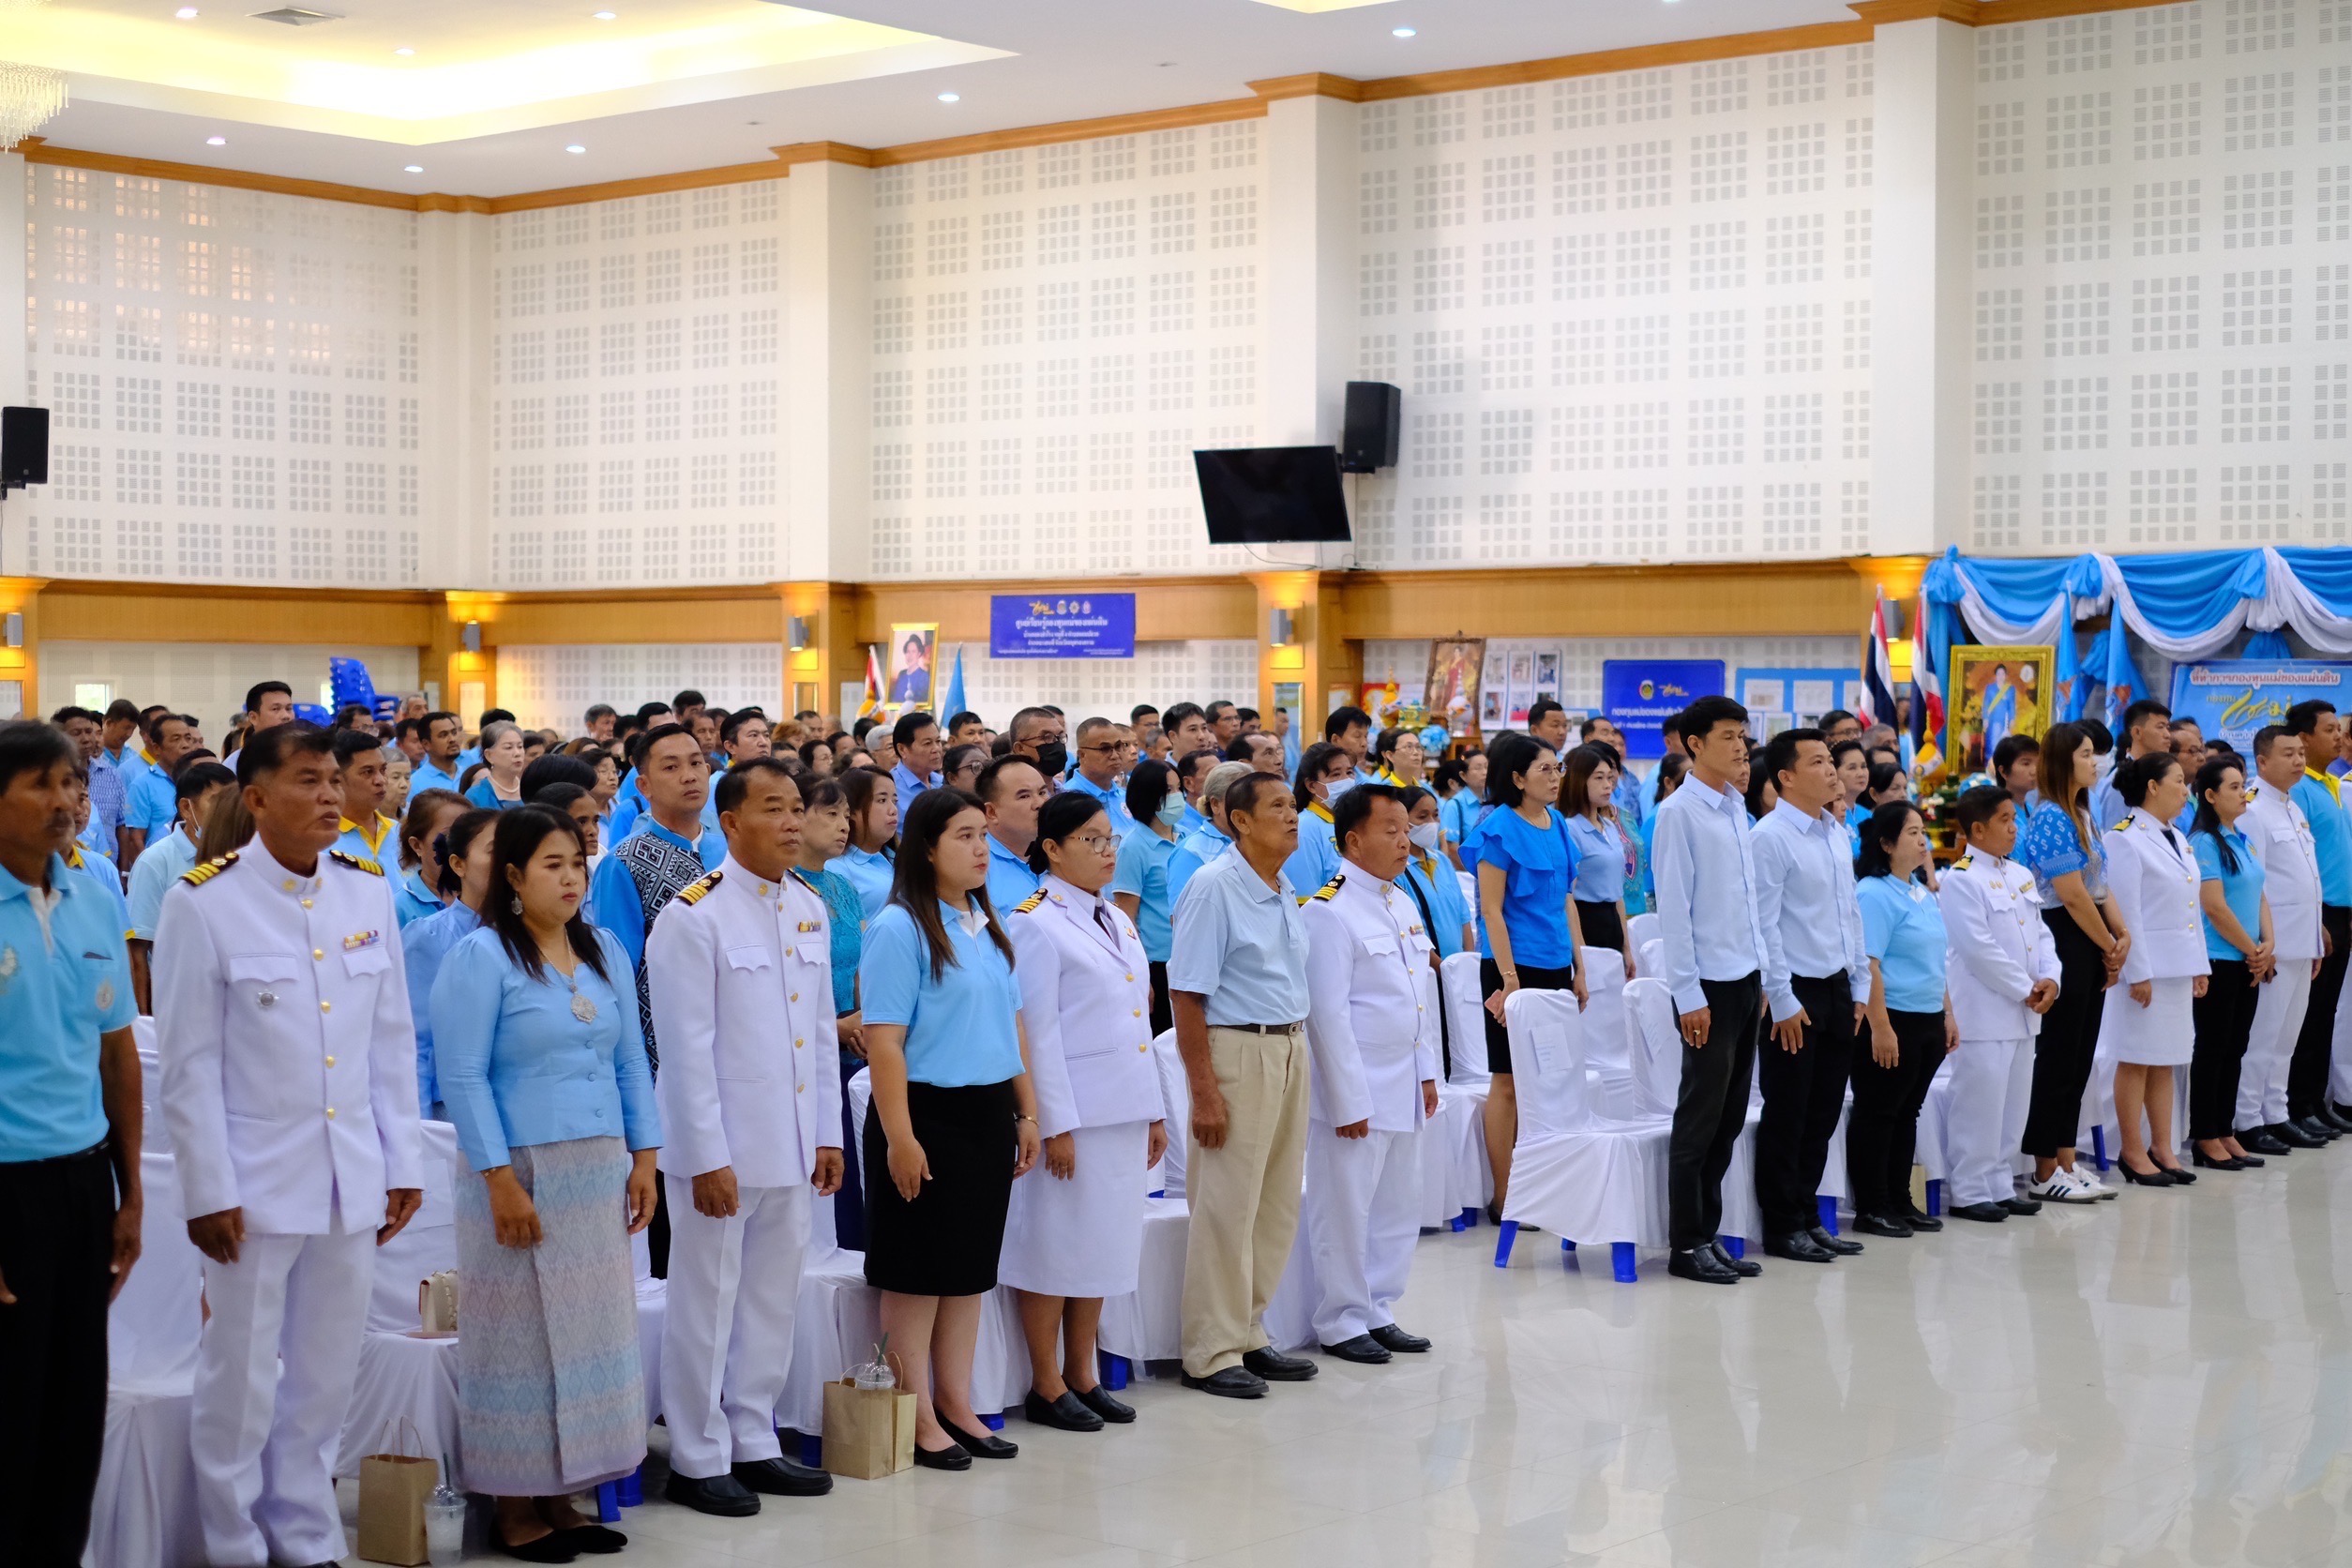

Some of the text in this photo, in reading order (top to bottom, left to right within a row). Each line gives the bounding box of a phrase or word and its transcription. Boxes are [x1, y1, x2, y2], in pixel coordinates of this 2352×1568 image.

[2190, 668, 2341, 688] ที่ทำการกองทุนแม่ของแผ่นดิน
